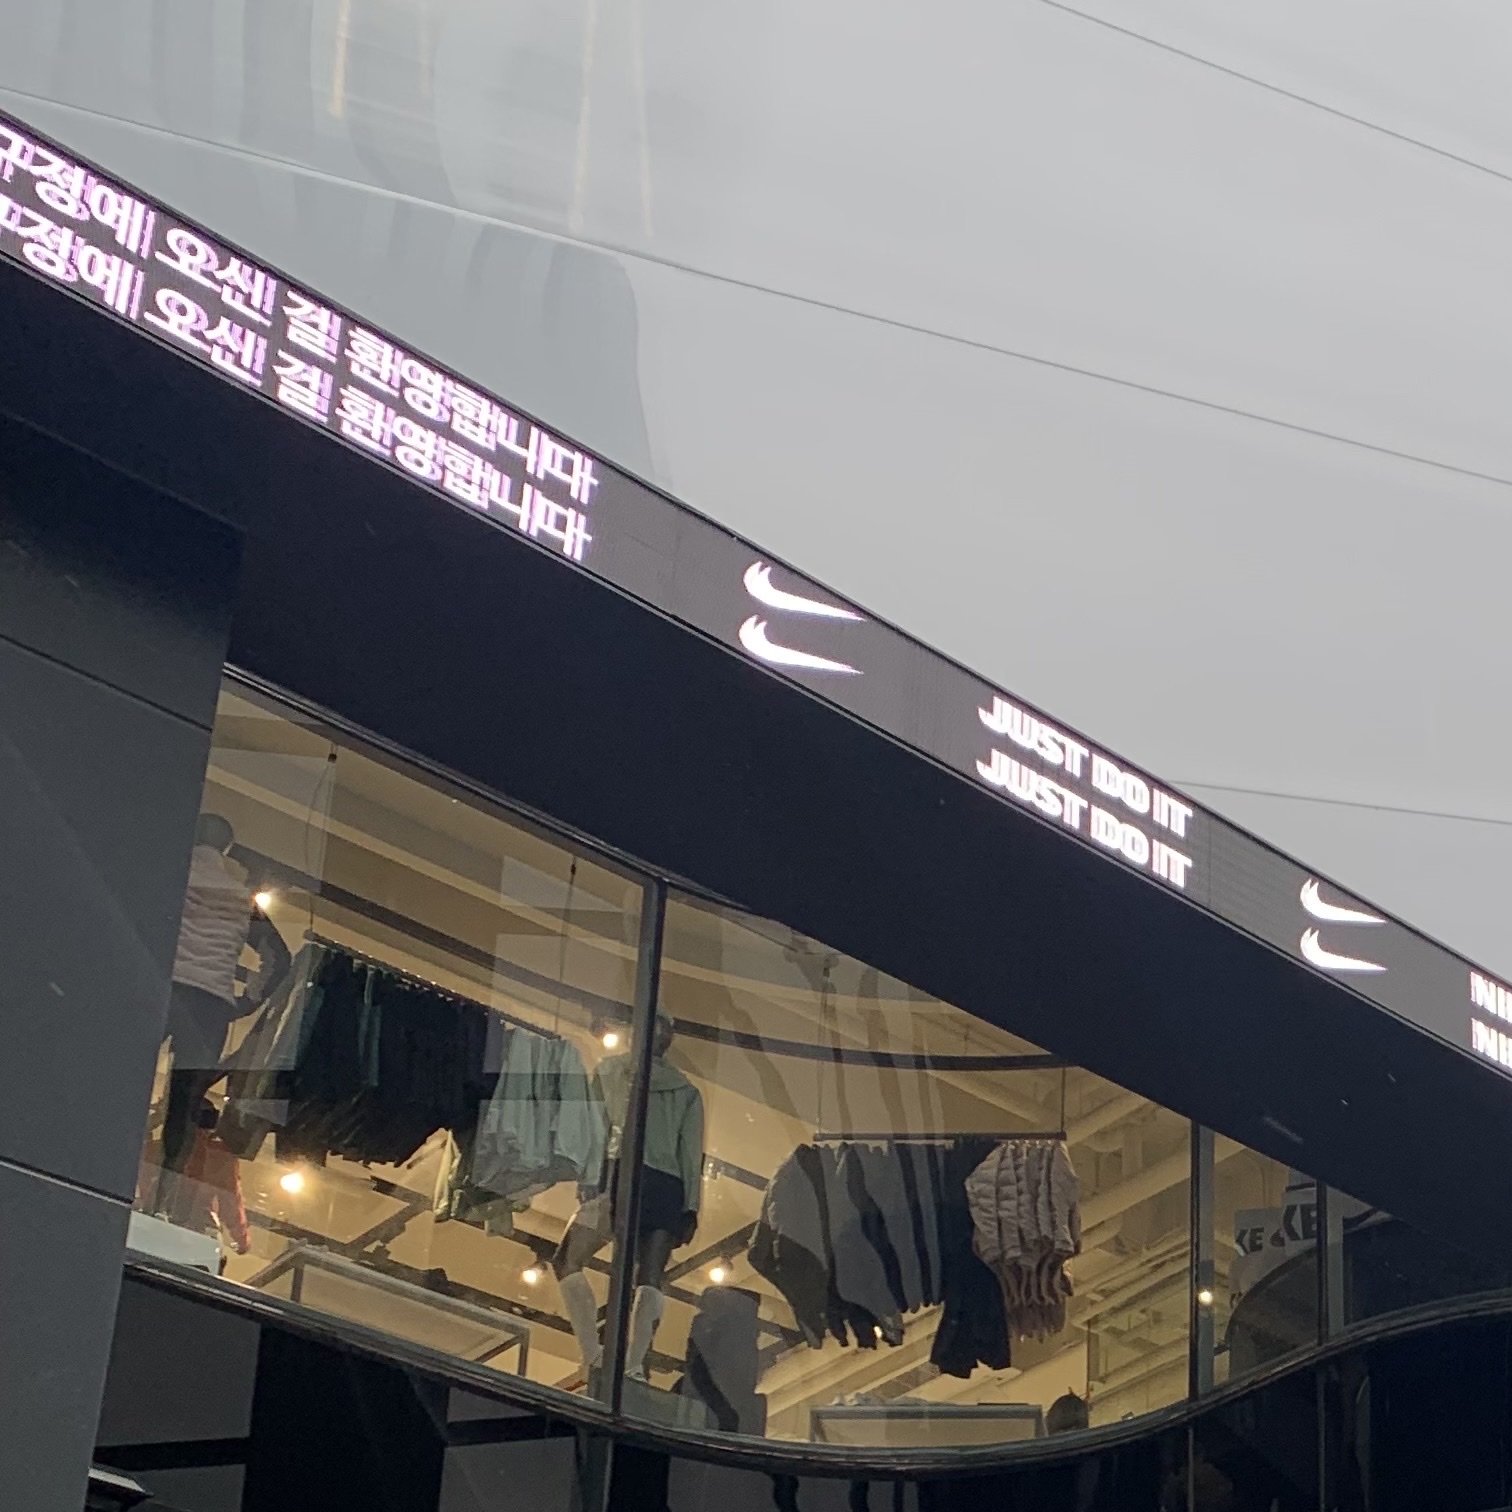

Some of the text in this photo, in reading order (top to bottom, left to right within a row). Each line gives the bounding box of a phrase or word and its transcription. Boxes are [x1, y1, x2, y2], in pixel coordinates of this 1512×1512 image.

[144, 287, 267, 388] 오신
[335, 384, 592, 561] 환영합니다
[155, 227, 277, 326] 오신
[344, 326, 599, 504] 환영합니다
[976, 749, 1192, 889] JUST DO IT
[977, 696, 1193, 838] JUST DO IT
